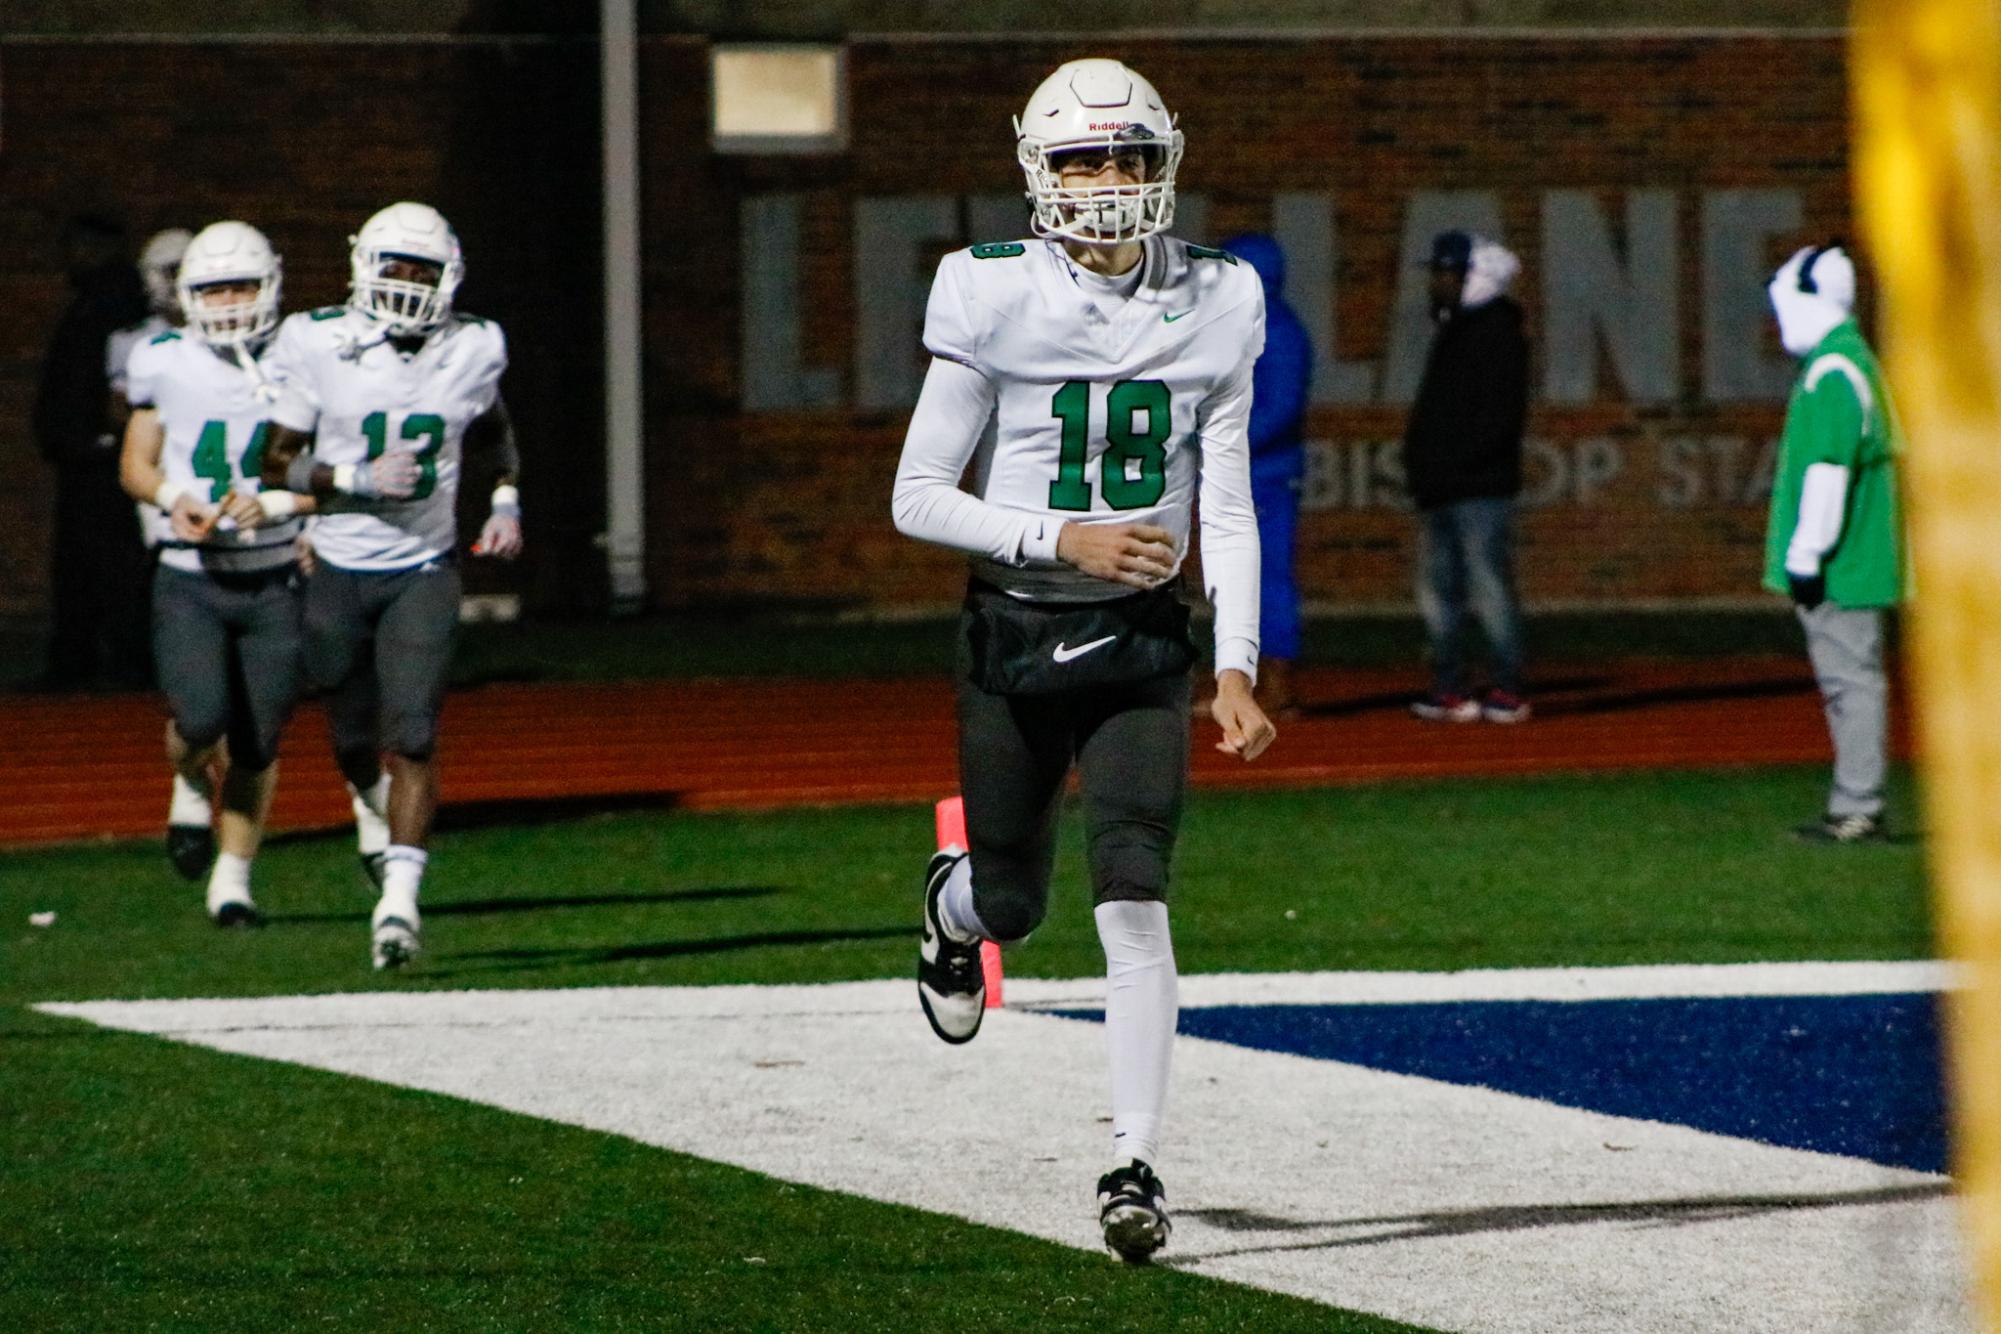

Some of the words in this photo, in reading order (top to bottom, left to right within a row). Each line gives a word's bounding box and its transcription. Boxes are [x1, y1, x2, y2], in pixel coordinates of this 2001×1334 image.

[1088, 120, 1129, 131] Riddell
[191, 420, 271, 503] 44
[362, 410, 446, 500] 13
[1048, 379, 1172, 512] 18
[1298, 437, 1623, 511] BISOP
